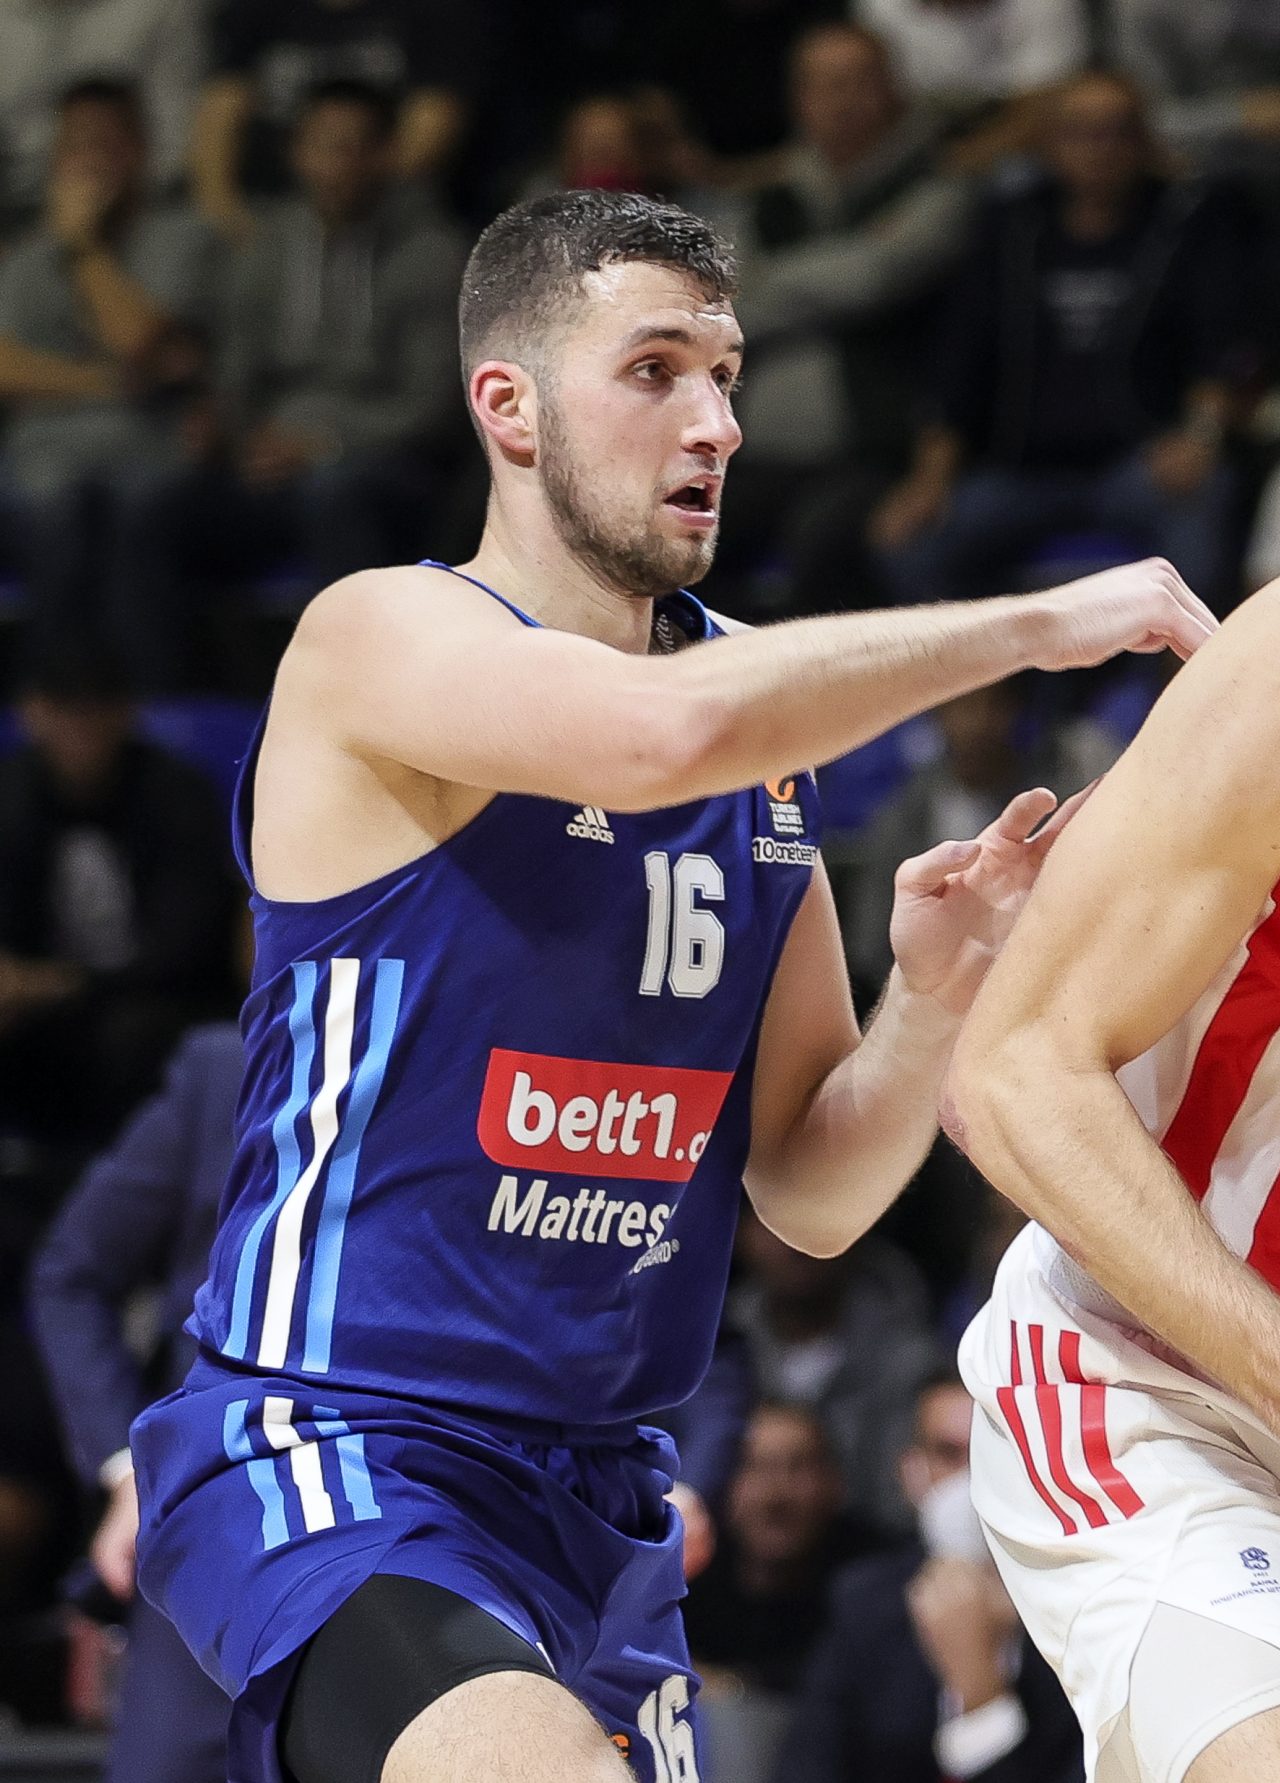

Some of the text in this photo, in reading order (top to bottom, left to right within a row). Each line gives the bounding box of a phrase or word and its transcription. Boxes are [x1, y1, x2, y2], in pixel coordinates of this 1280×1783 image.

[566, 822, 615, 845] adidas
[639, 851, 725, 999] 16
[487, 1174, 679, 1248] Mattres
[637, 1674, 701, 1783] 16
